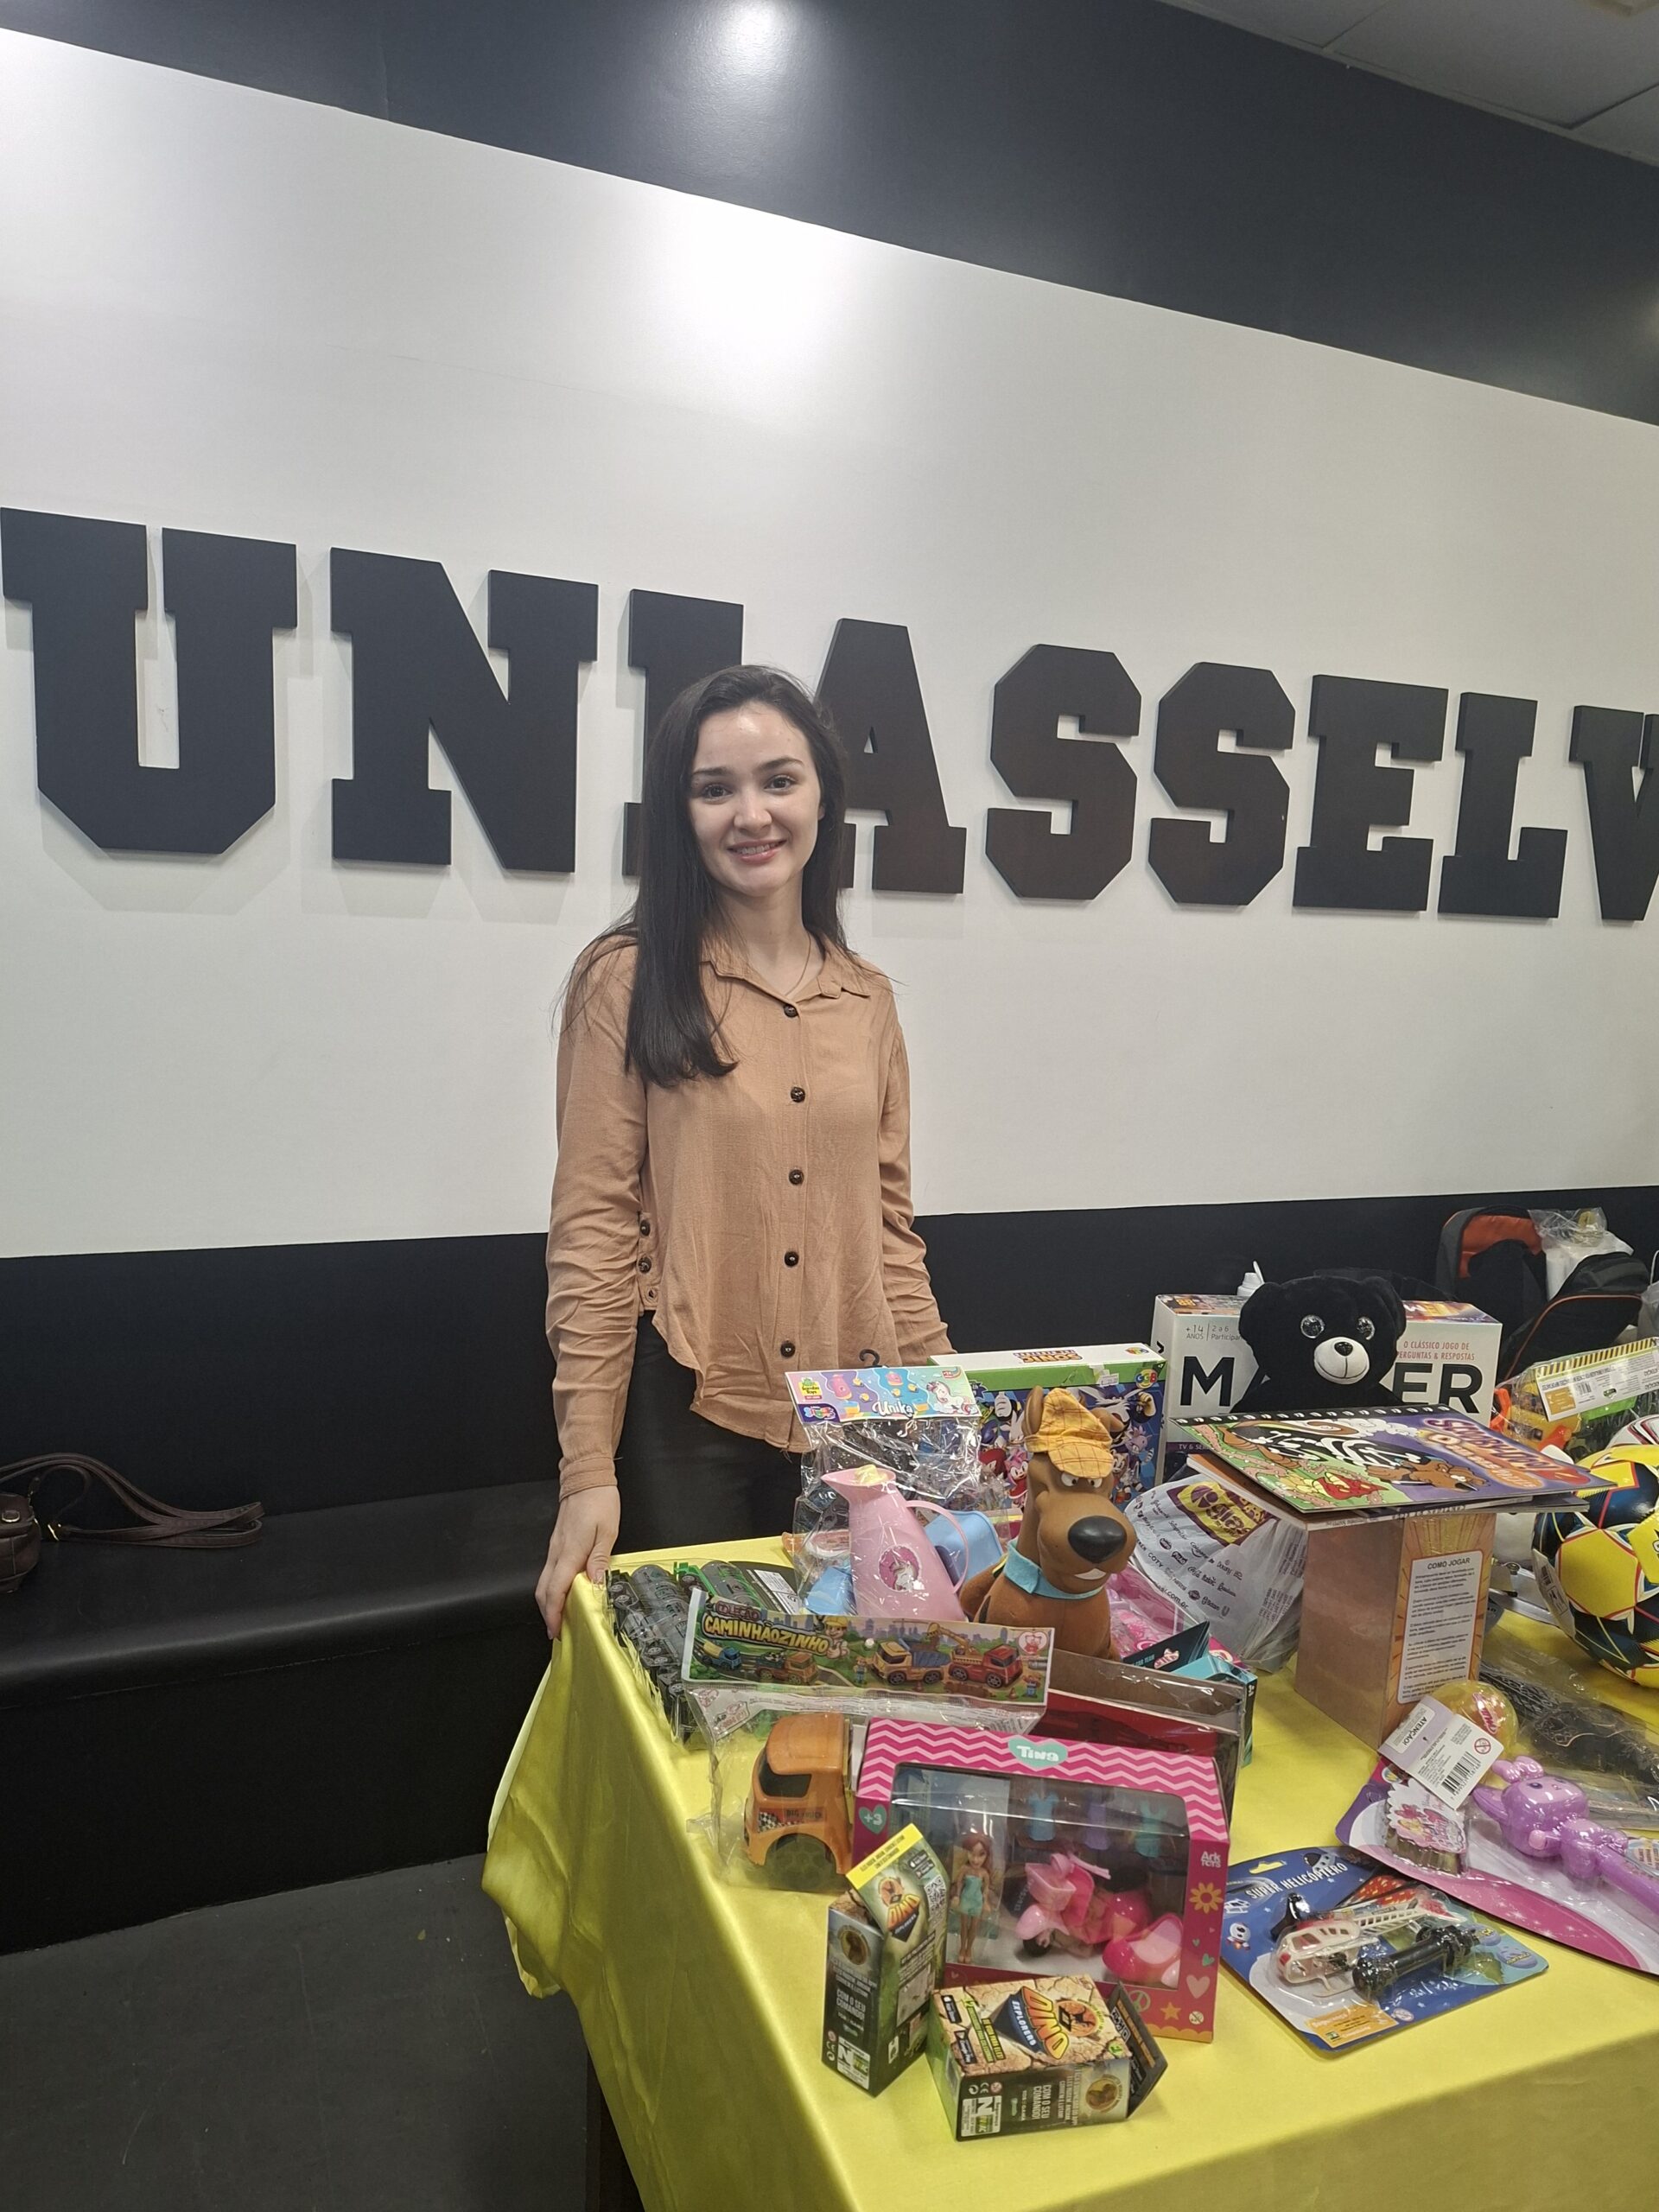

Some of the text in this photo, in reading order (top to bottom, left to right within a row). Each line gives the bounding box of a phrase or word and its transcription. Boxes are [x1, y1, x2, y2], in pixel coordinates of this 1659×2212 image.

[1410, 1340, 1440, 1349] CLÁSSICO
[1022, 1353, 1083, 1363] SONIC
[872, 1401, 914, 1418] Unika
[1146, 1552, 1164, 1568] COTY
[1448, 1558, 1471, 1567] JOGAR
[704, 1615, 830, 1653] CAMINHÃOZINHO
[1402, 1716, 1427, 1746] ATENÇÃO!
[864, 1814, 883, 1825] +3
[1201, 1851, 1221, 1862] Ark
[1245, 1863, 1349, 1900] SUPER HELICÓPTERO
[887, 1894, 921, 1931] DINO
[1011, 2000, 1037, 2046] EXPLORERS
[1023, 1986, 1070, 2059] DINO
[1042, 2084, 1052, 2099] COM
[1030, 2086, 1042, 2119] COMANDO!
[1040, 2106, 1049, 2118] SEU
